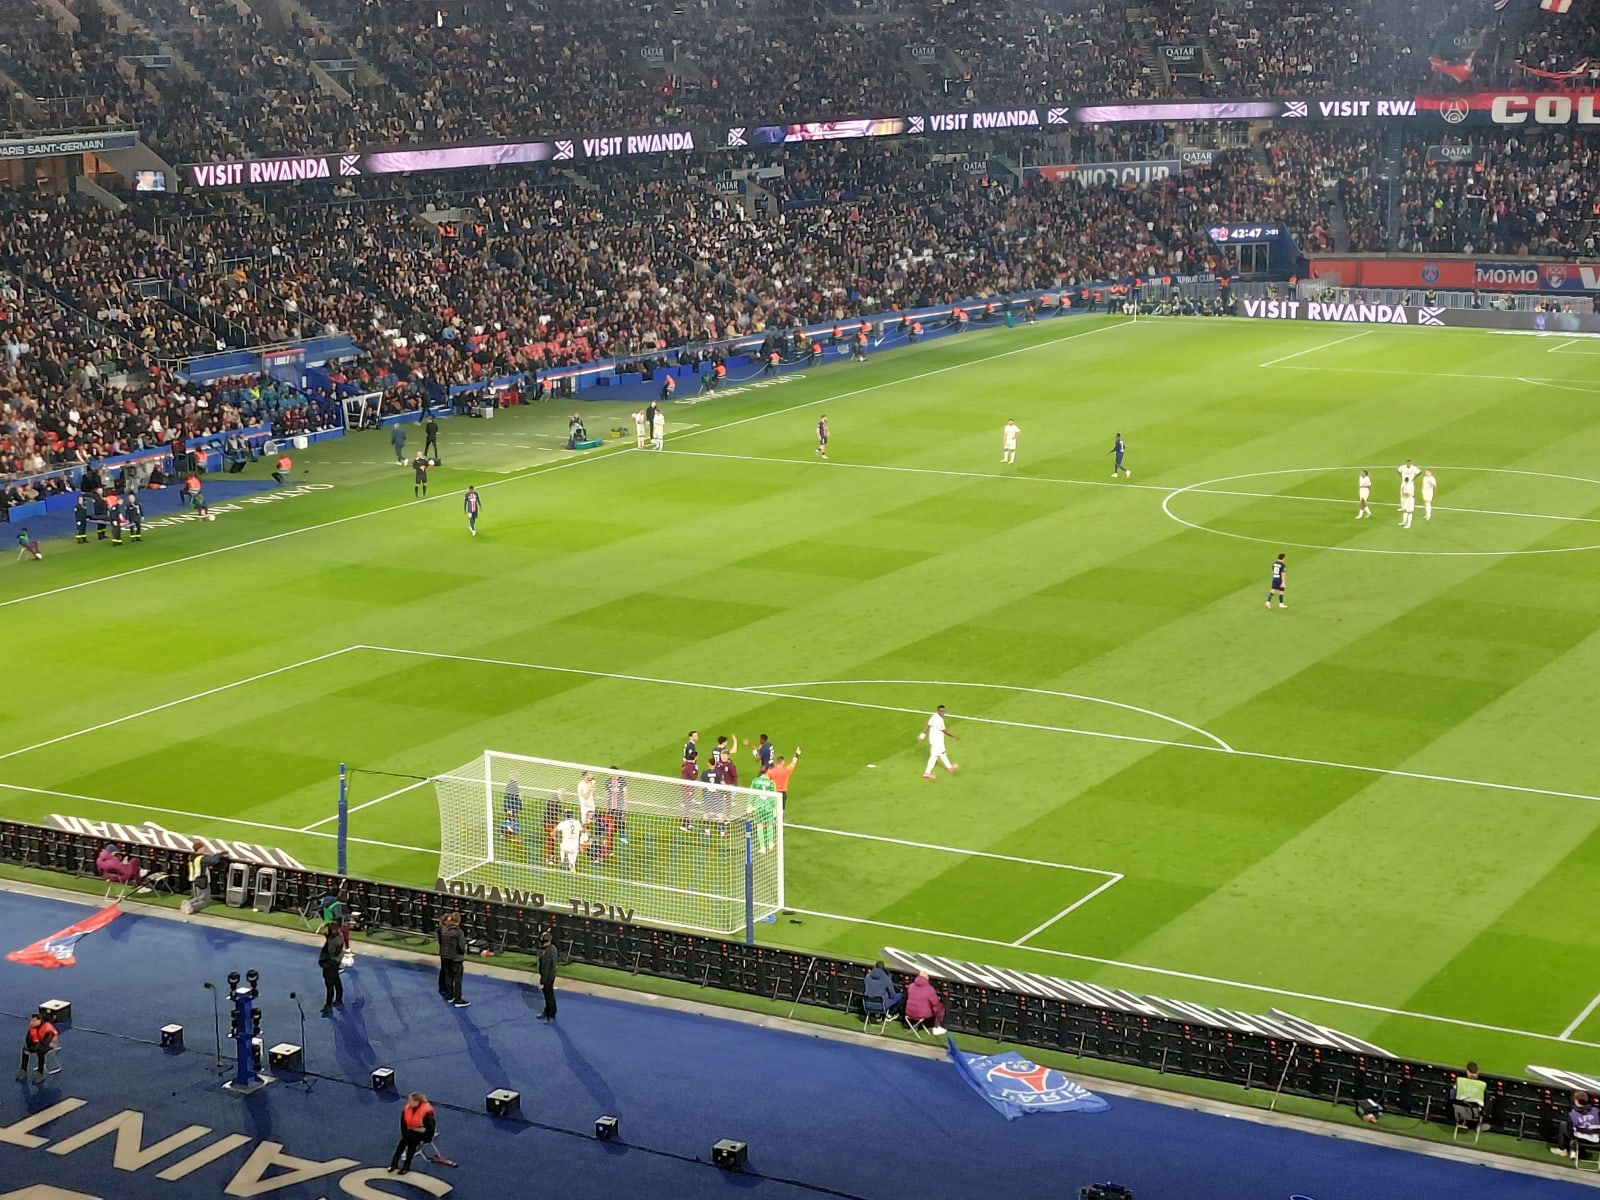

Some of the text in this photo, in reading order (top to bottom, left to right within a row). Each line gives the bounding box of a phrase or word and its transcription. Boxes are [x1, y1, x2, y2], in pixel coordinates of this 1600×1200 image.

[911, 47, 936, 57] QATAR
[1166, 47, 1195, 57] QATAR
[1319, 101, 1370, 117] VISIT
[930, 109, 1039, 131] VISIT RWANDA
[28, 139, 104, 154] SAINT-GERMAIN
[582, 131, 694, 157] VISIT RWANDA
[1183, 152, 1212, 161] QATAR
[1441, 147, 1472, 157] QATAR
[193, 157, 330, 187] VISIT RWANDA
[963, 161, 987, 172] QATAR
[715, 181, 738, 191] QATAR
[1231, 228, 1262, 238] 42:47
[1475, 268, 1538, 284] MOMO
[1243, 300, 1408, 323] VISIT RWANDA
[570, 824, 576, 835] 2
